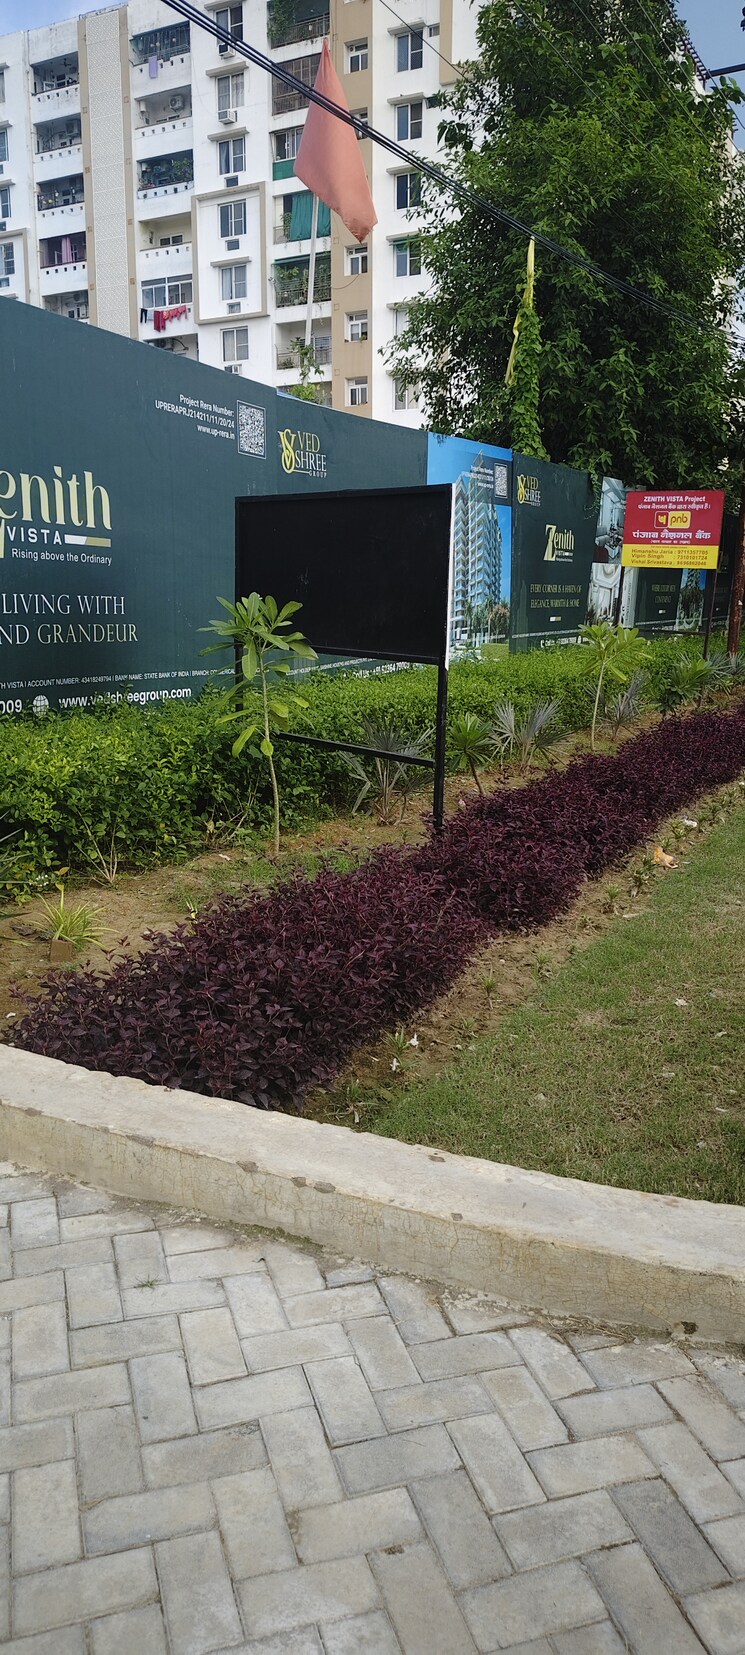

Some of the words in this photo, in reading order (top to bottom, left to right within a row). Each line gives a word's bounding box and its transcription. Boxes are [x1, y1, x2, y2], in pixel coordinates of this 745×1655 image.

[179, 394, 200, 407] Project
[200, 400, 213, 411] Rera
[212, 403, 235, 417] Number:
[196, 424, 236, 440] www.up-rera.in
[297, 430, 321, 453] VED
[295, 450, 327, 472] SHREE
[308, 470, 327, 478] GROUP
[526, 475, 539, 490] VED
[0, 465, 112, 530] enith
[524, 488, 541, 503] SHREE
[685, 496, 706, 504] Project
[671, 514, 688, 526] pnb
[6, 525, 62, 545] VISTA
[543, 524, 575, 561] Zenith
[632, 529, 658, 539] पंजाब
[11, 548, 38, 562] Rising
[40, 550, 65, 561] above
[66, 552, 79, 562] the
[80, 553, 112, 566] Ordinary
[2, 593, 71, 615] LIVING
[77, 595, 125, 615] WITH
[37, 623, 138, 645] GRANDEUR
[6, 680, 24, 689] VISTA
[27, 678, 55, 688] ACCOUNT
[55, 677, 81, 685] NUMBER:
